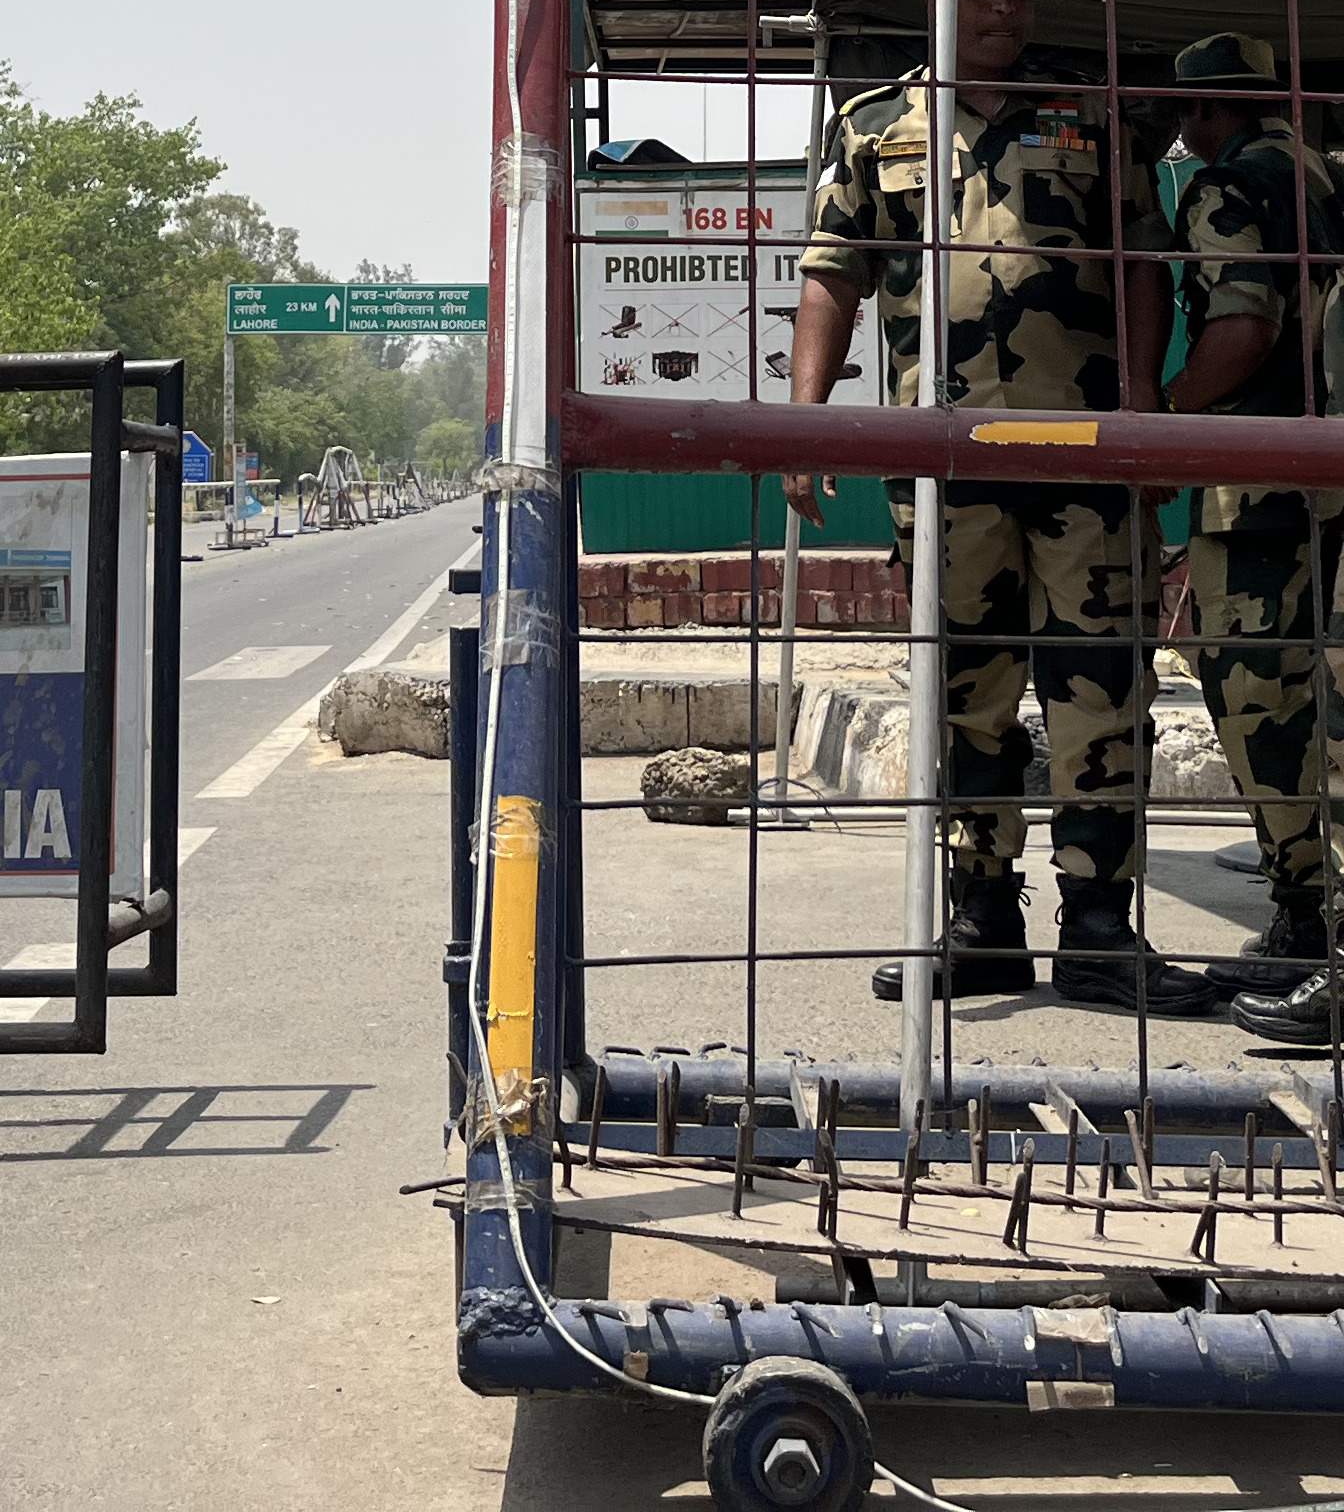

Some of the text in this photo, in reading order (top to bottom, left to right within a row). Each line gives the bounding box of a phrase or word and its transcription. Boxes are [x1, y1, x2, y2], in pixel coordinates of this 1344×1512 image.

[682, 208, 727, 231] 168
[285, 302, 318, 313] 23 KM
[233, 318, 279, 329] LAHORE
[348, 319, 379, 330] INDIA
[386, 319, 439, 330] PAKISTAN
[440, 319, 487, 330] BORDER
